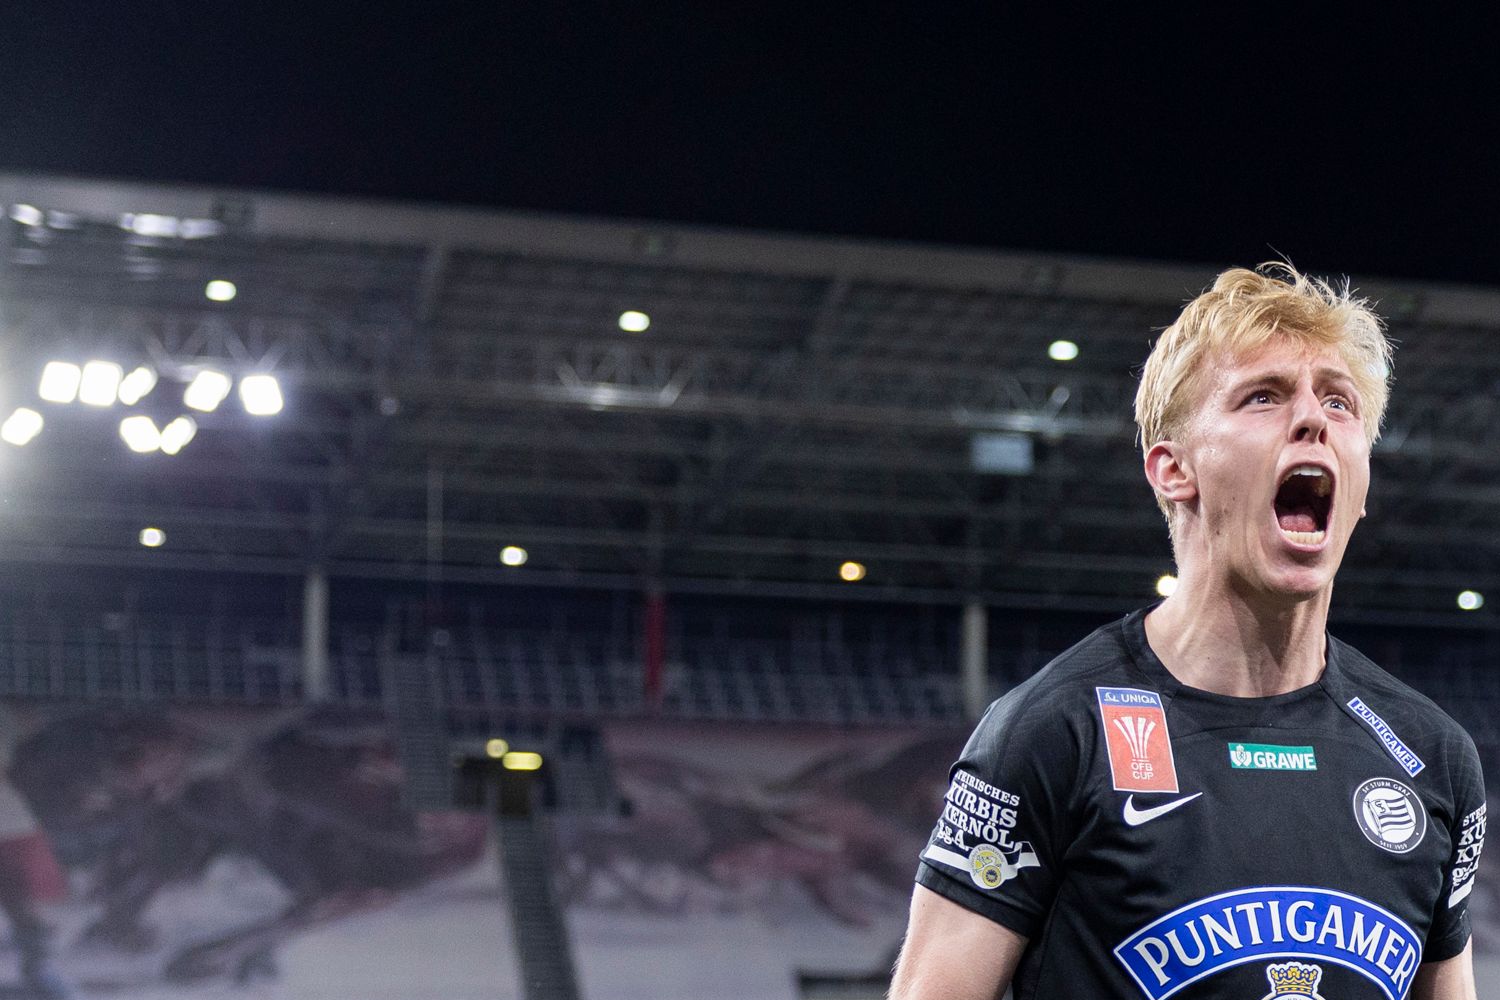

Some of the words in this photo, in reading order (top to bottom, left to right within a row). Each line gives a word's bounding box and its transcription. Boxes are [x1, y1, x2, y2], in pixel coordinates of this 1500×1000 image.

[1120, 693, 1157, 705] UNIQA
[1353, 701, 1419, 772] PUNTIGAMER
[1253, 751, 1318, 770] GRAWE
[1132, 771, 1154, 781] CUP
[1370, 780, 1391, 789] STURM
[1392, 783, 1412, 797] GRAZ
[1133, 900, 1417, 993] PUNTIGAMER
